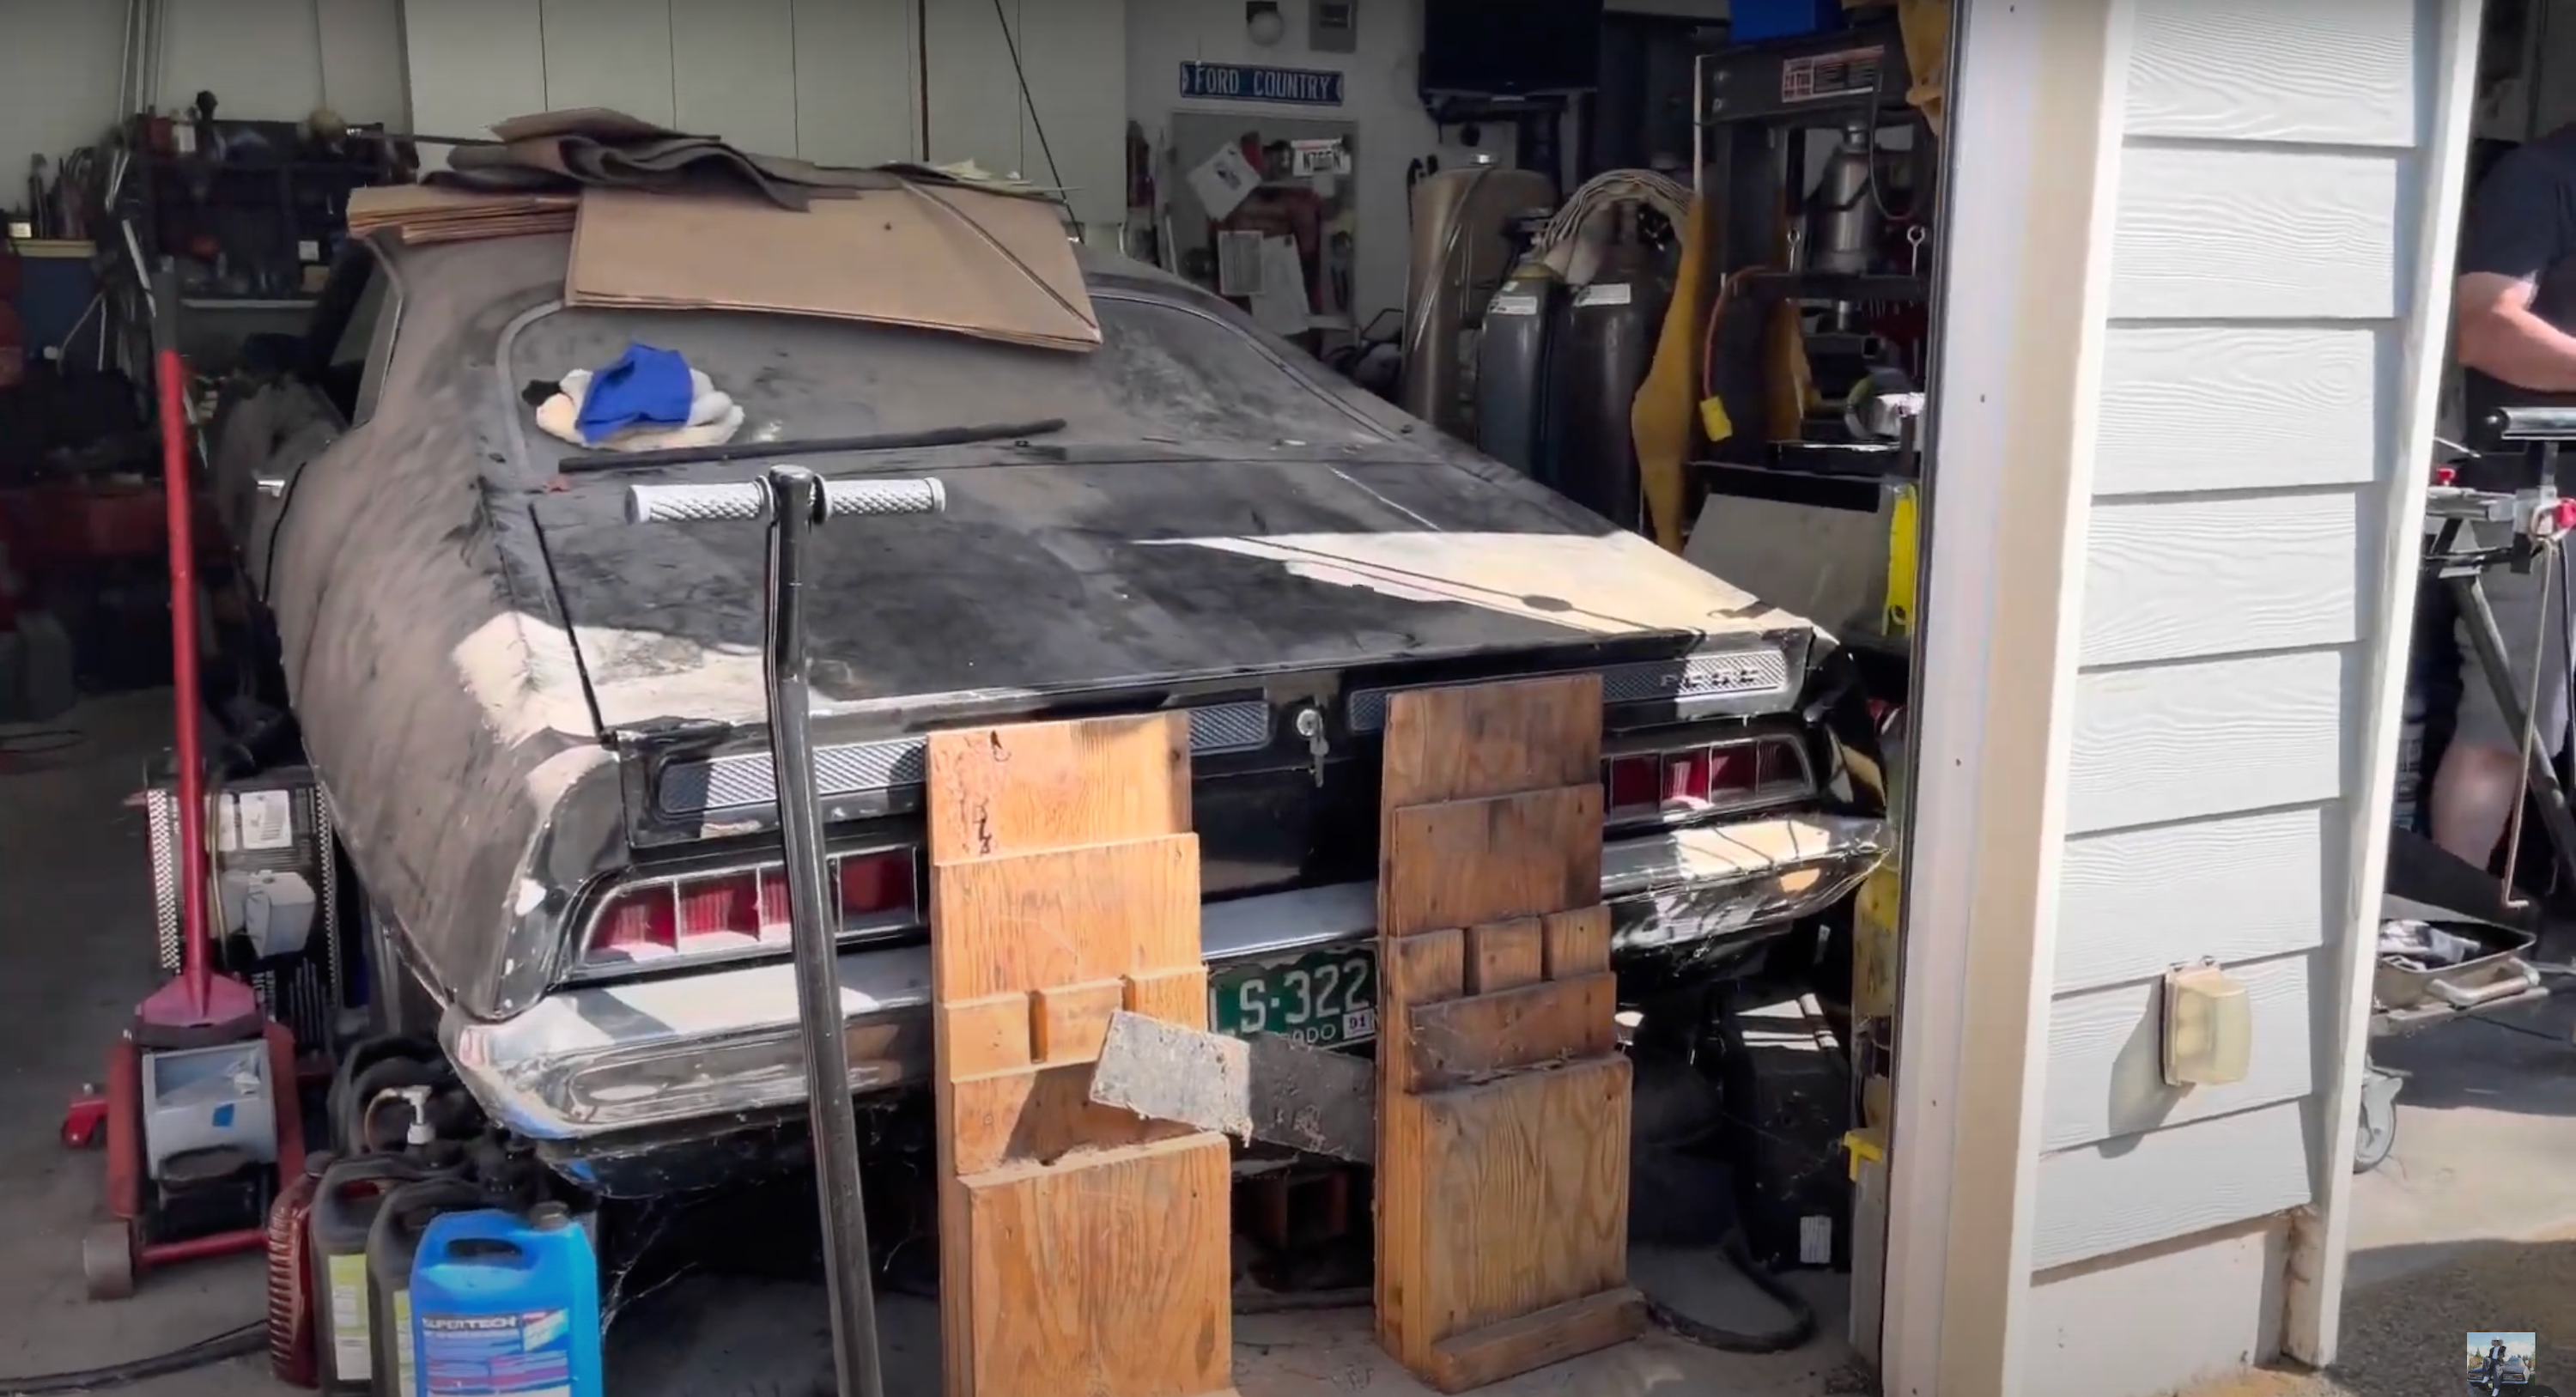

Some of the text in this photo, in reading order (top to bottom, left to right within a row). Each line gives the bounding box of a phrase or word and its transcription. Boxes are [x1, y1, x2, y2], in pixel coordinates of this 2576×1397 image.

[1195, 67, 1330, 100] FORD COUNTRY
[1349, 1014, 1366, 1030] 91
